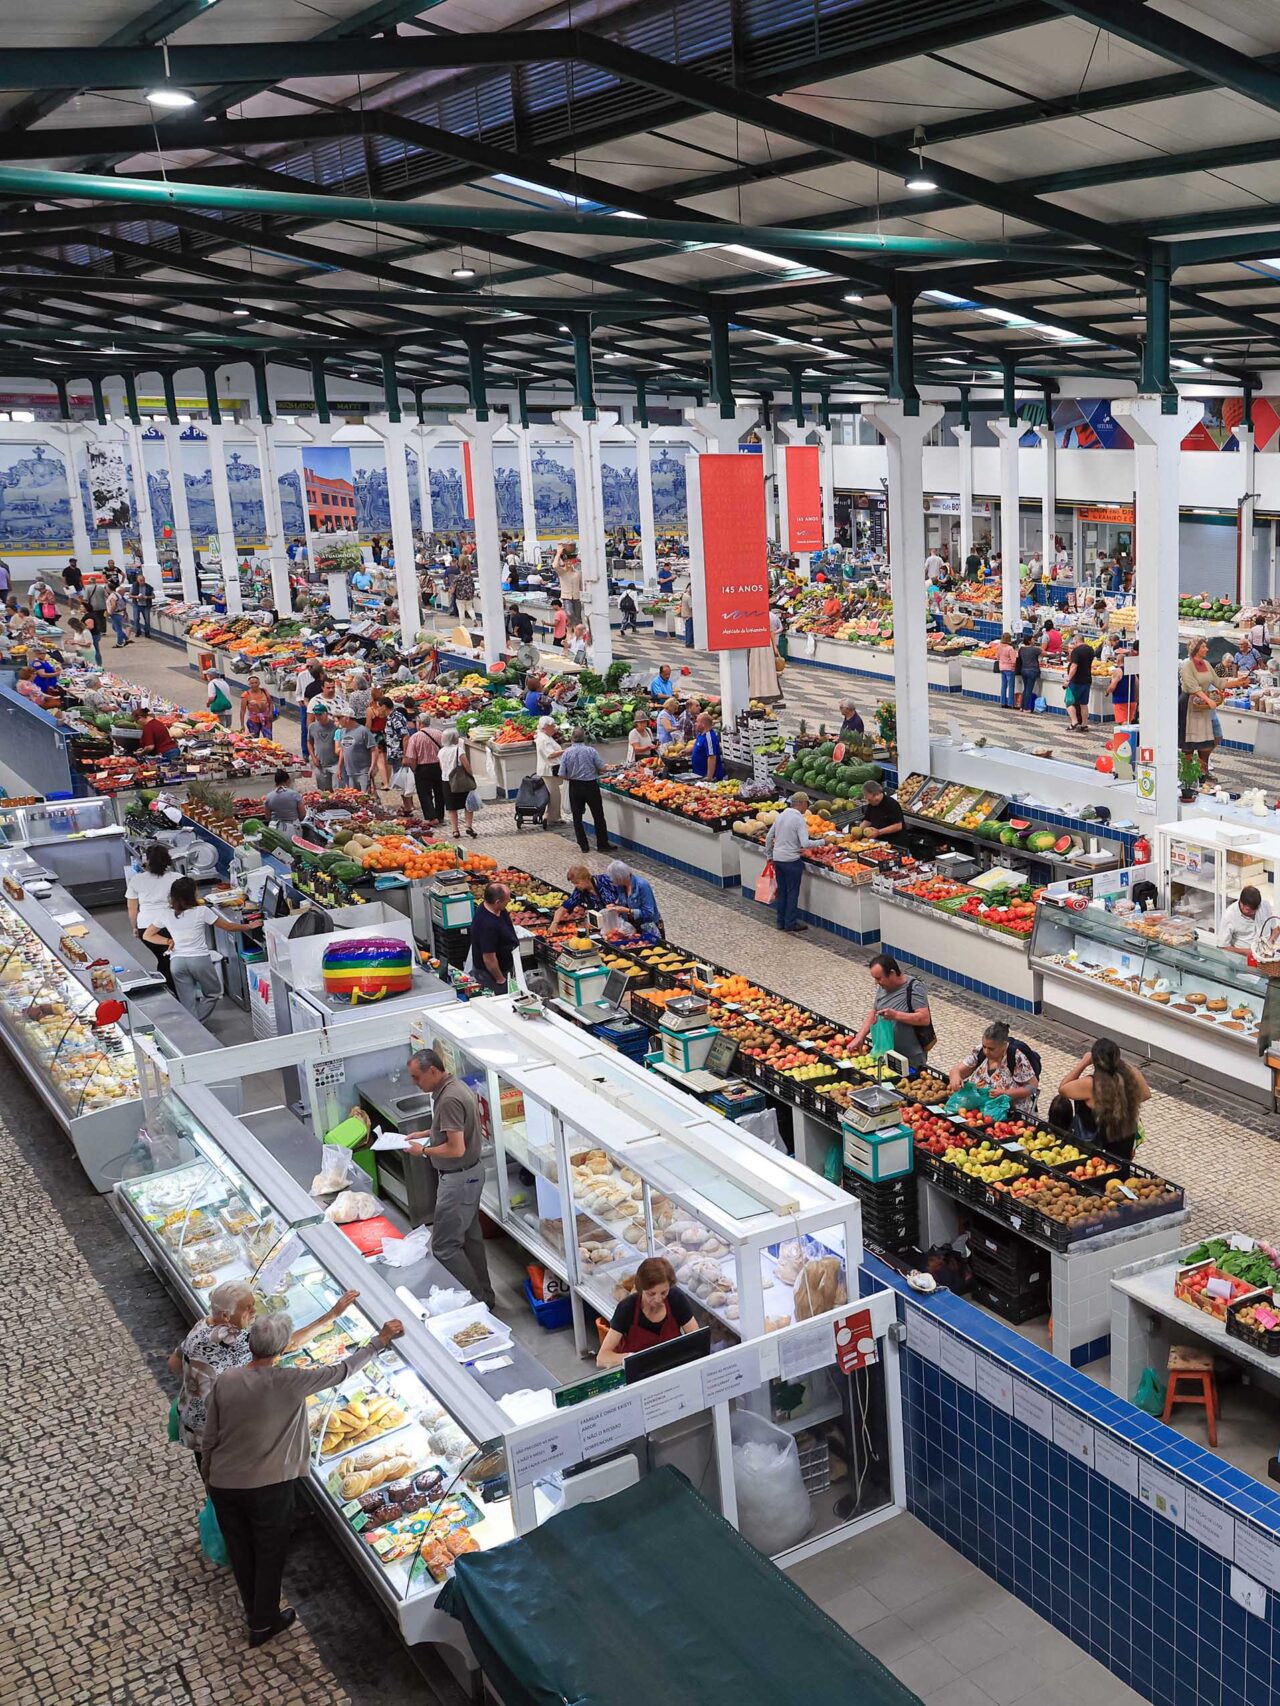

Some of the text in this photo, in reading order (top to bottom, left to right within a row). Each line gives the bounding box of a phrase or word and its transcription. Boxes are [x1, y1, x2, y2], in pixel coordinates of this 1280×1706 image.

[721, 584, 763, 594] 145 ANOS
[581, 1423, 596, 1432] AMOR
